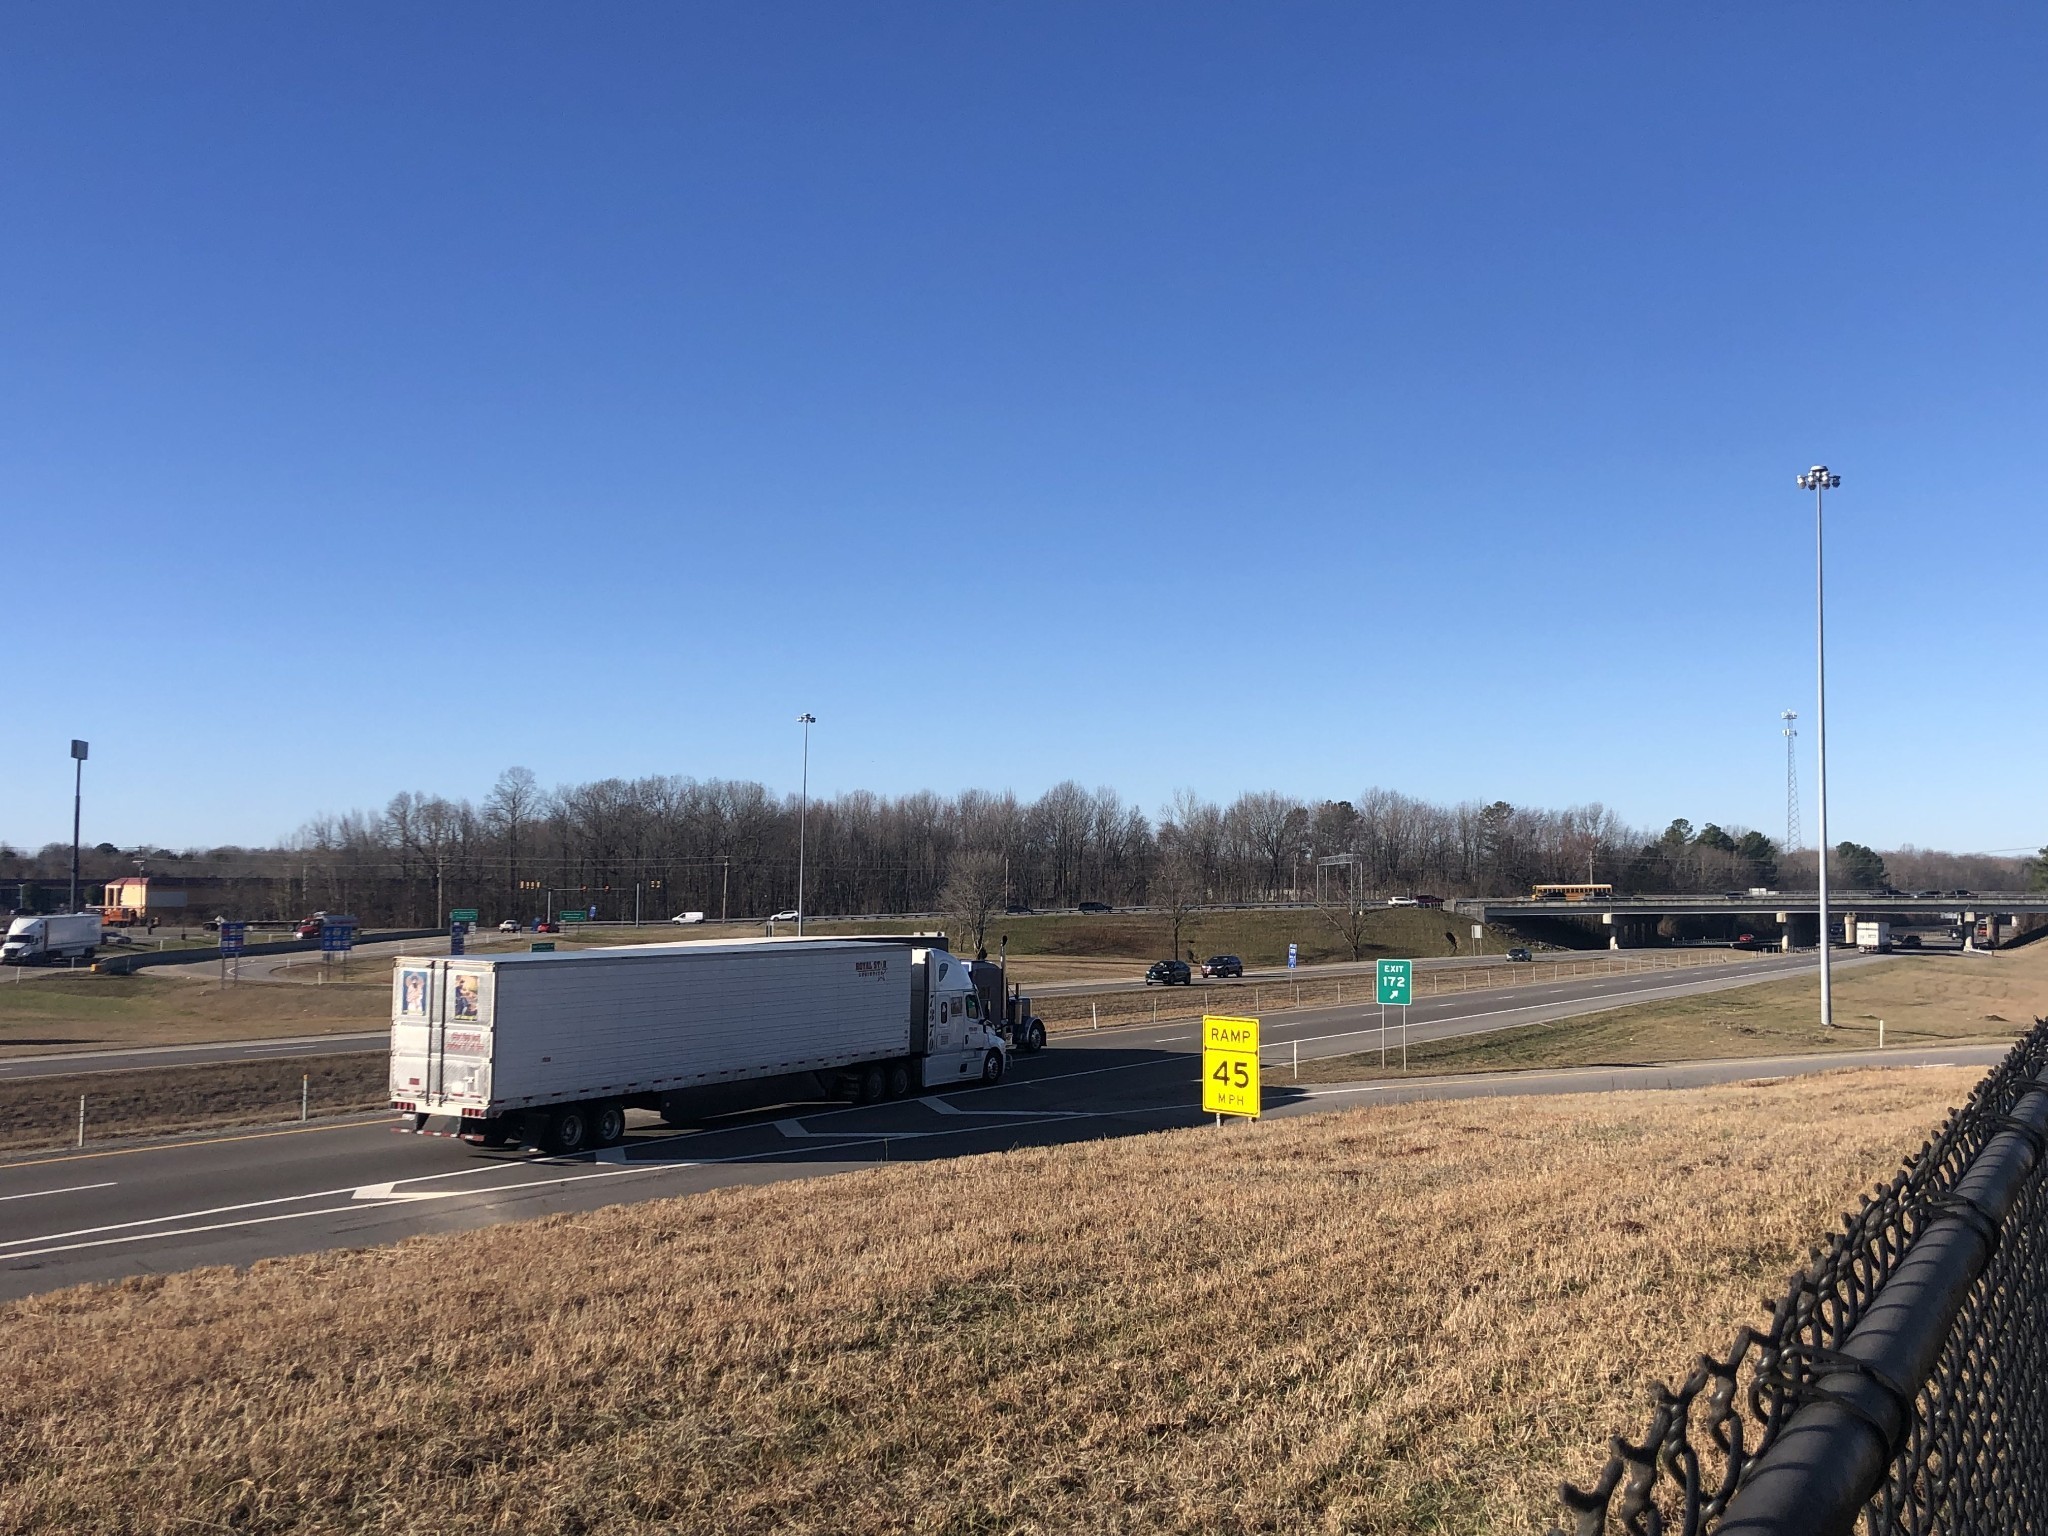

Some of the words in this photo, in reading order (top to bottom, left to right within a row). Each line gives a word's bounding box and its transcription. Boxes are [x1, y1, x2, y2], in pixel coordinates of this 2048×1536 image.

[855, 961, 872, 971] ROYAL
[1384, 965, 1404, 973] EXIT
[1383, 976, 1405, 987] 172
[1211, 1028, 1251, 1043] RAMP
[1212, 1060, 1250, 1089] 45
[1218, 1093, 1244, 1106] MPH
